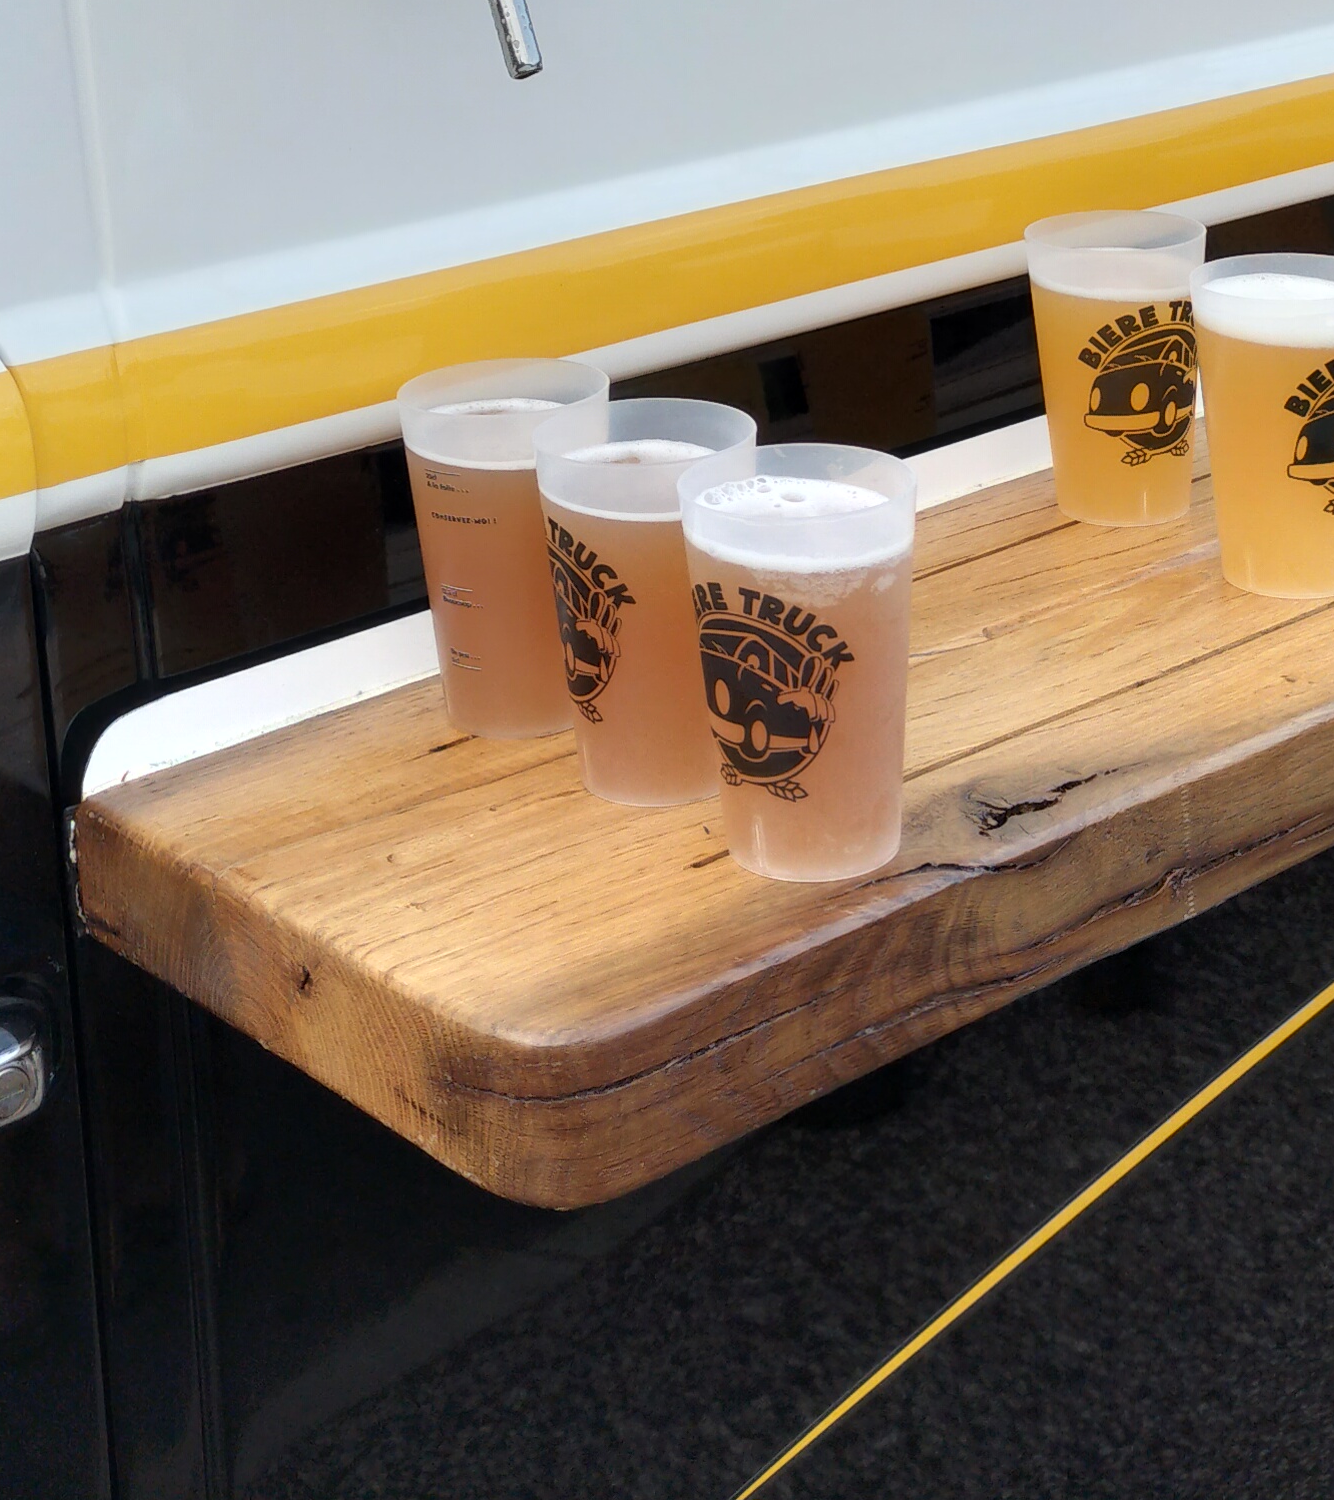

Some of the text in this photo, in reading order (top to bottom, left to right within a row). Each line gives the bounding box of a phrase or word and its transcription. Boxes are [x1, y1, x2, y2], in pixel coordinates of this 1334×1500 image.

[1078, 304, 1160, 370] BIERE
[547, 515, 637, 611] TRUCK
[738, 586, 856, 672] TRUCK
